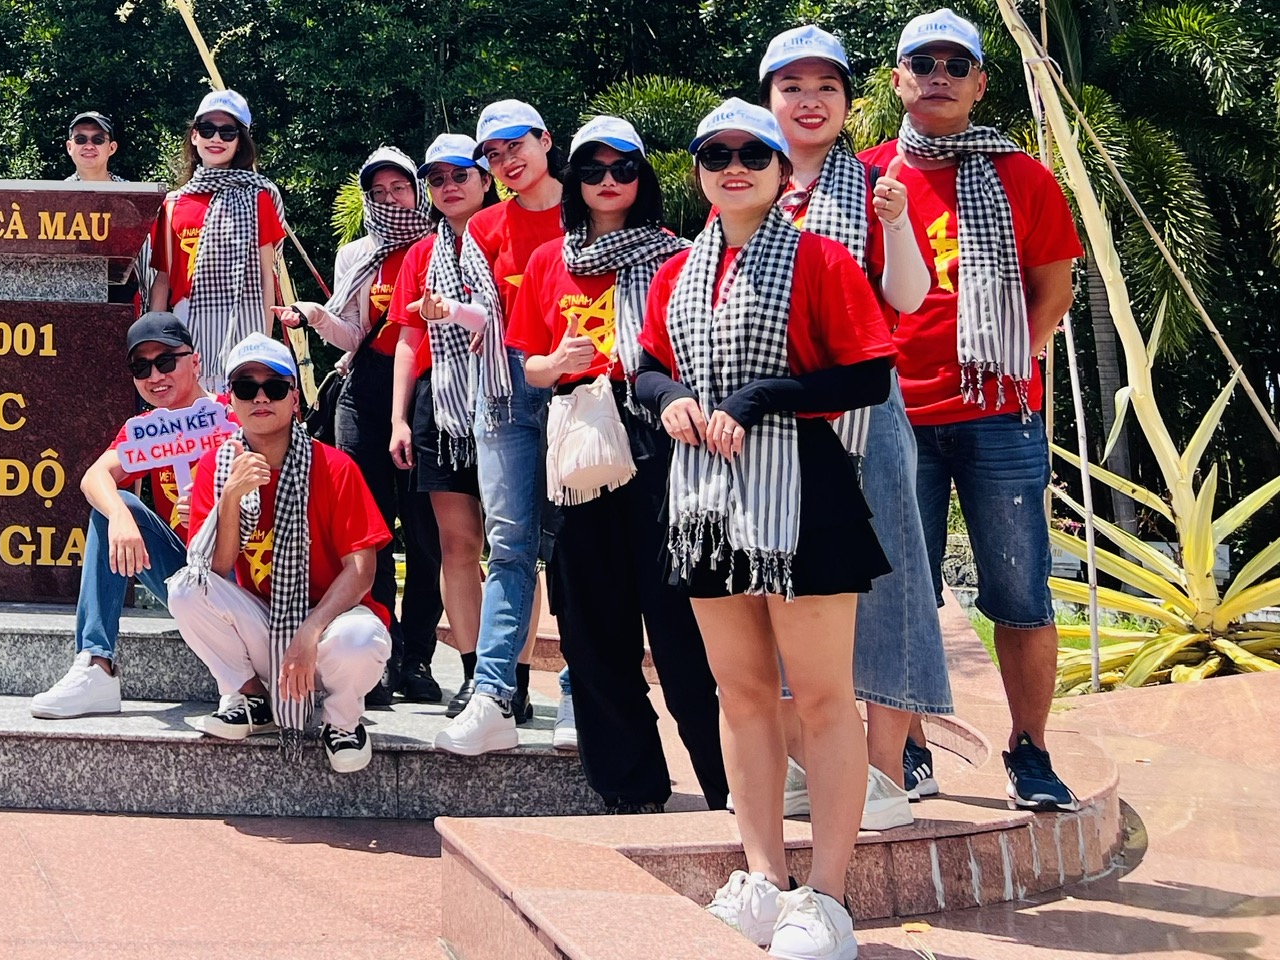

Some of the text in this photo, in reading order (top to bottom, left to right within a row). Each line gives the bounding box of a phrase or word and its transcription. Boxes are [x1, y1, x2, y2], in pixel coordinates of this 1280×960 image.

[37, 212, 112, 242] MAU
[133, 405, 217, 440] ĐOÀN KẾT
[125, 449, 147, 464] TA
